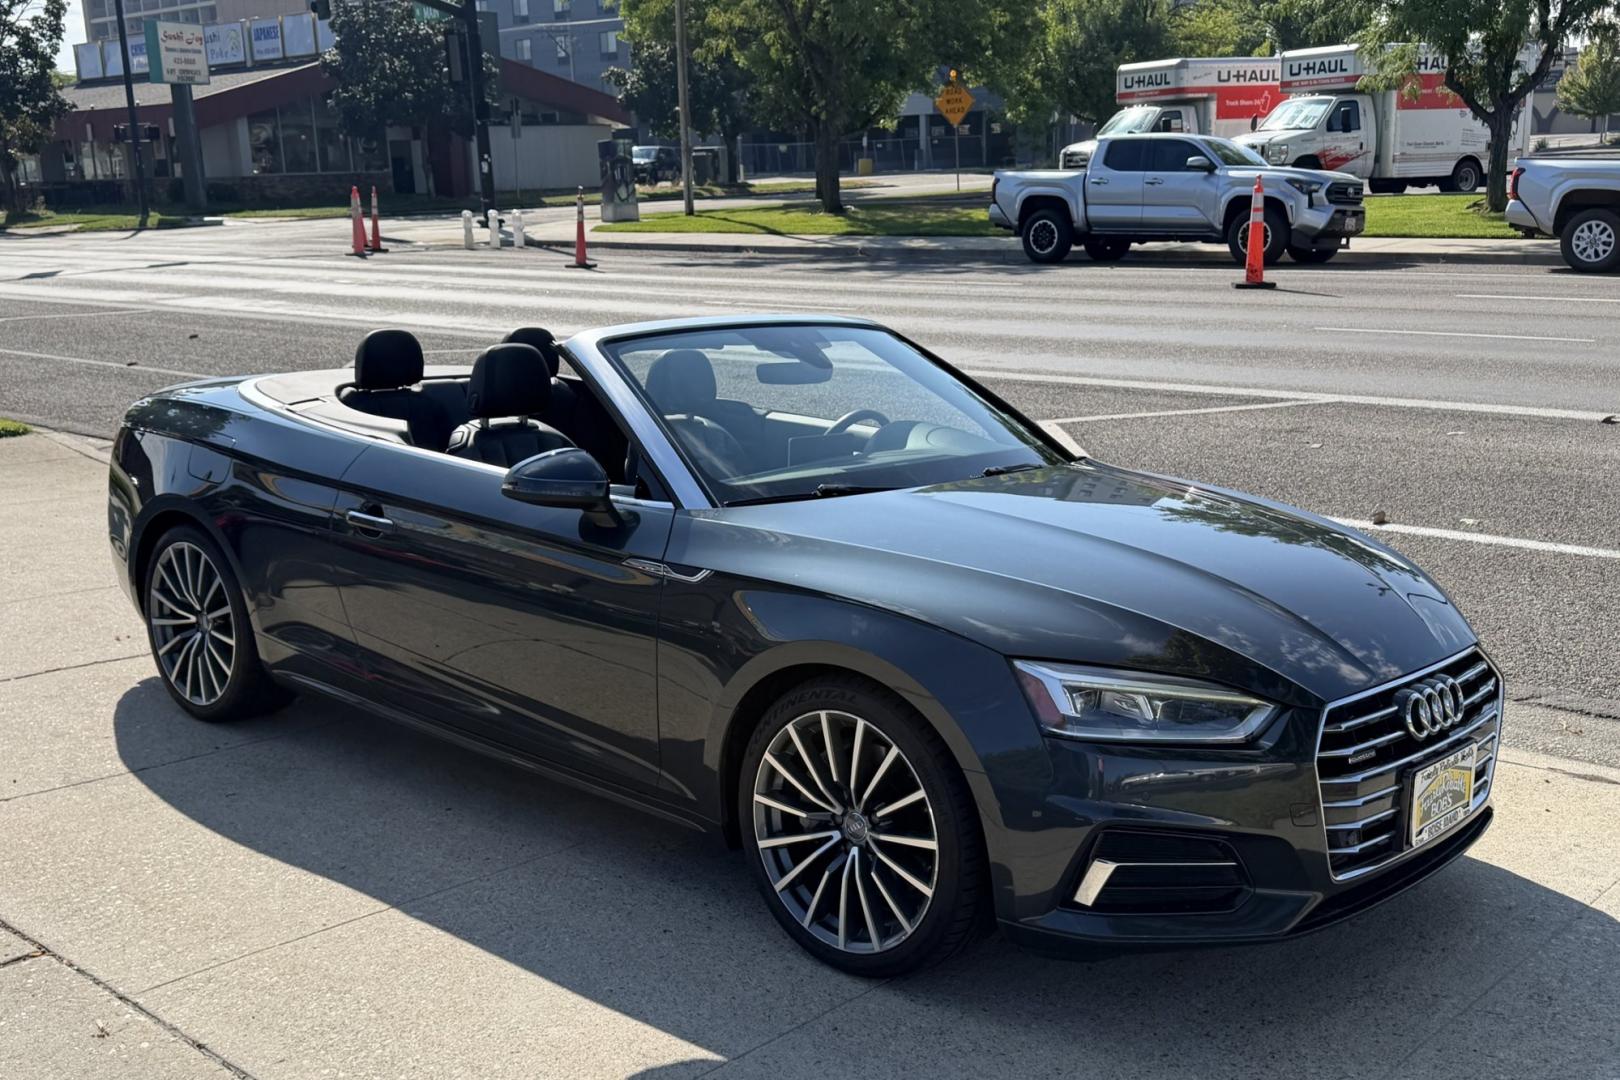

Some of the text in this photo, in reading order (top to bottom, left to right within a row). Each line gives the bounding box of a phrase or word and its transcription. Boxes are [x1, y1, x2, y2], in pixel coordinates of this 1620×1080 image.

[161, 30, 184, 43] Sushi
[205, 32, 221, 44] ushi
[1289, 58, 1348, 77] U-HAUL
[1124, 72, 1171, 89] U-HAUL
[1217, 69, 1279, 83] U-HAUL
[946, 97, 962, 105] WORK
